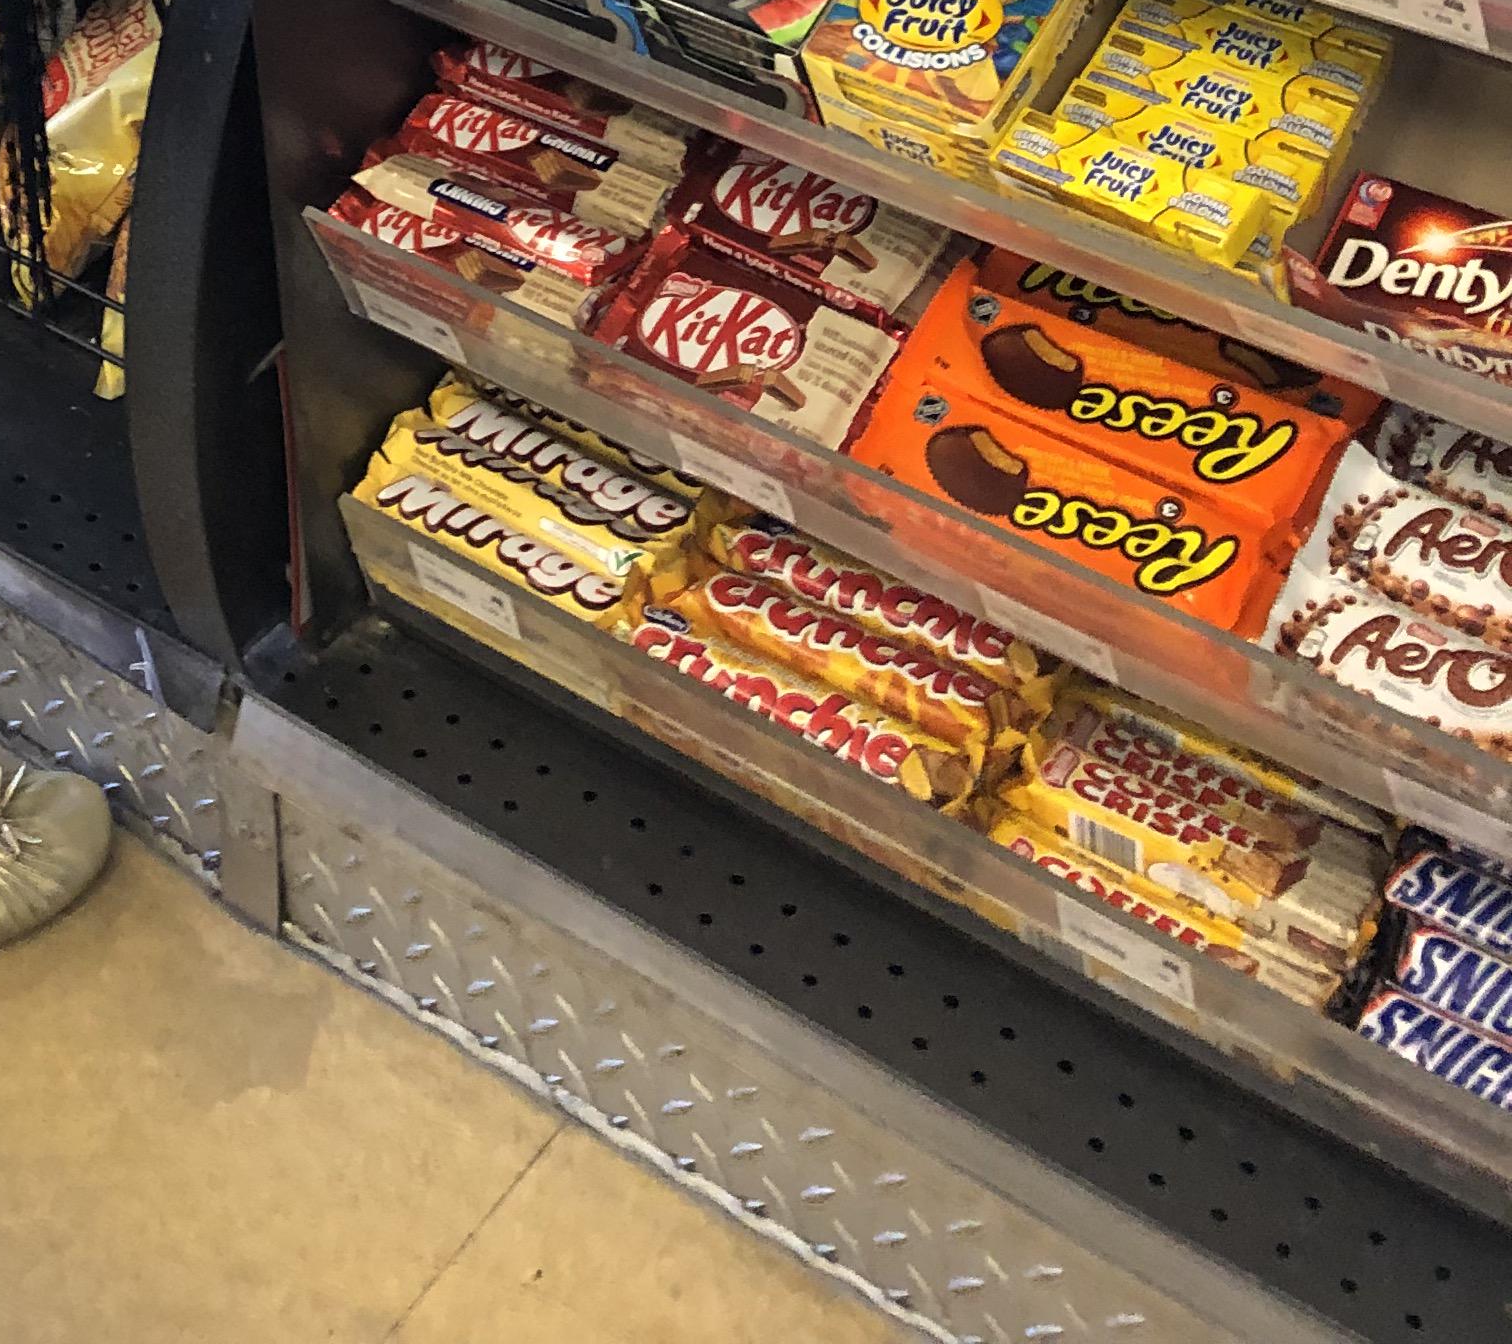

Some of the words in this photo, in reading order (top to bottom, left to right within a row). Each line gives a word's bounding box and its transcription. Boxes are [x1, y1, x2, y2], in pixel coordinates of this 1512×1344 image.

[850, 23, 987, 70] COLLISIONS
[881, 9, 972, 44] Fruit
[1210, 37, 1274, 71] Fruit
[1216, 21, 1284, 53] Juicy
[431, 100, 538, 151] KitKat
[1180, 90, 1244, 124] Fruit
[1186, 74, 1254, 106] Juicy
[1091, 149, 1157, 183] Juicy
[1148, 125, 1217, 157] Juicy
[720, 159, 867, 236] KitKat
[1083, 167, 1144, 203] Fruit
[646, 276, 796, 373] KitKat
[445, 399, 691, 532] Mirage
[1070, 386, 1297, 483] Reese
[376, 474, 626, 612] Mirage
[1012, 489, 1240, 596] Reese
[731, 526, 1014, 667] crunchie
[705, 572, 991, 706] crunchie
[631, 623, 916, 787] crunchie
[1092, 737, 1228, 808] CRISP
[1102, 720, 1273, 812] COFFEE
[1072, 778, 1214, 845] CRISP
[1082, 761, 1261, 849] COFFEE
